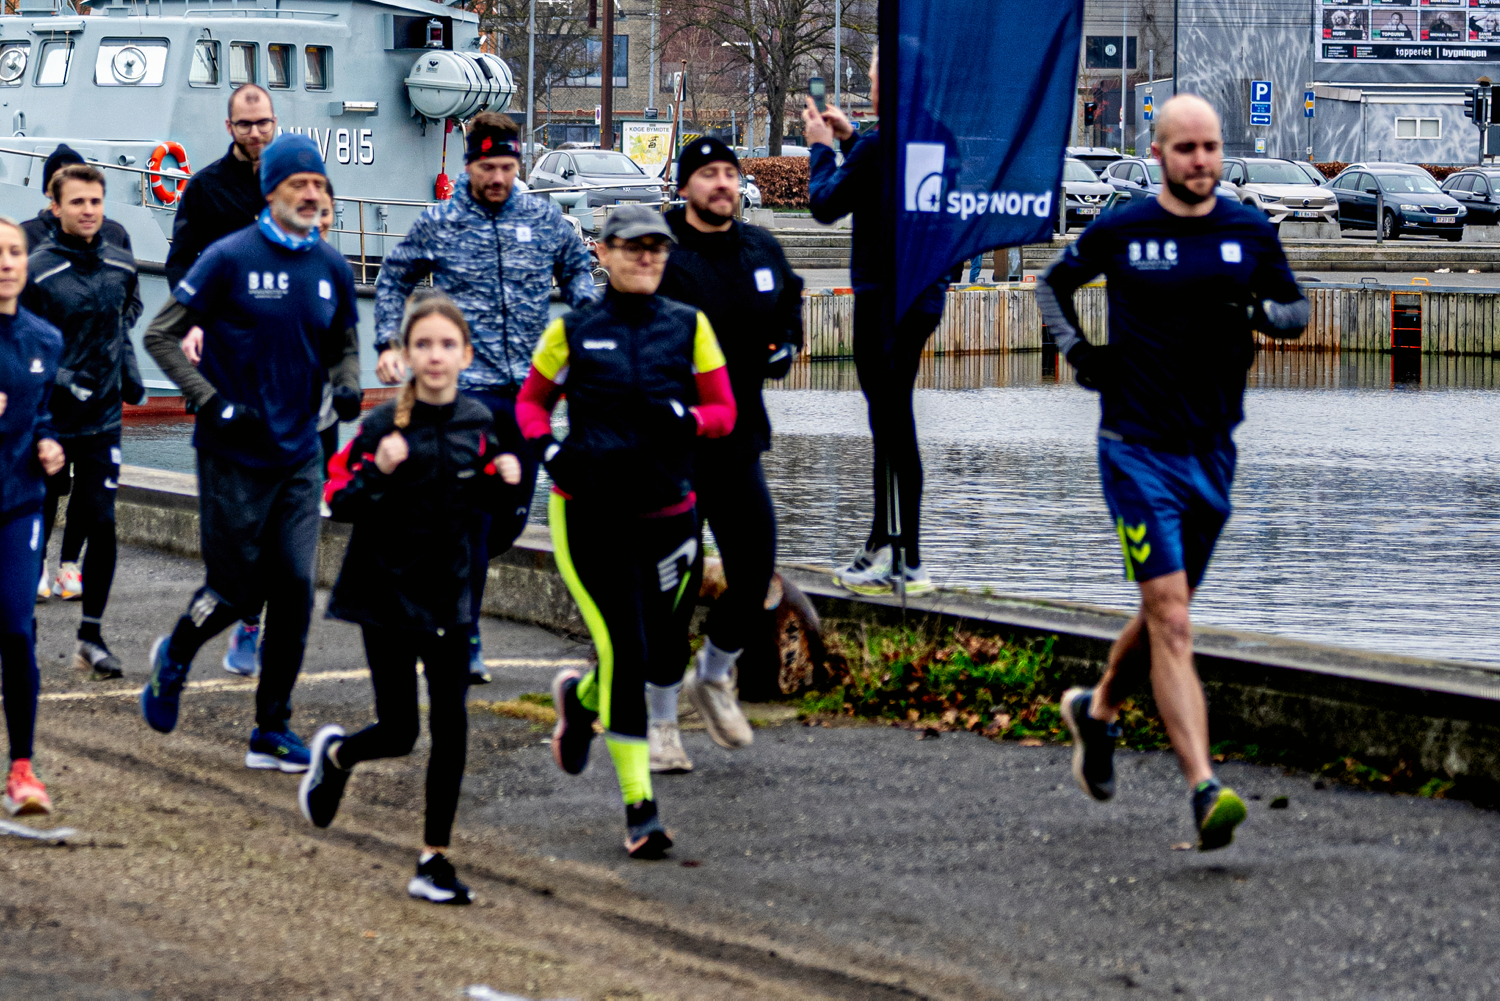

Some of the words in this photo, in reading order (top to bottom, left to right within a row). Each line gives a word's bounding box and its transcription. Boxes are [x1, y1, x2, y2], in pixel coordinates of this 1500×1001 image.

[1395, 47, 1432, 58] tapperiet
[1442, 48, 1487, 58] bygningen
[1256, 83, 1268, 101] P
[336, 128, 374, 165] 815
